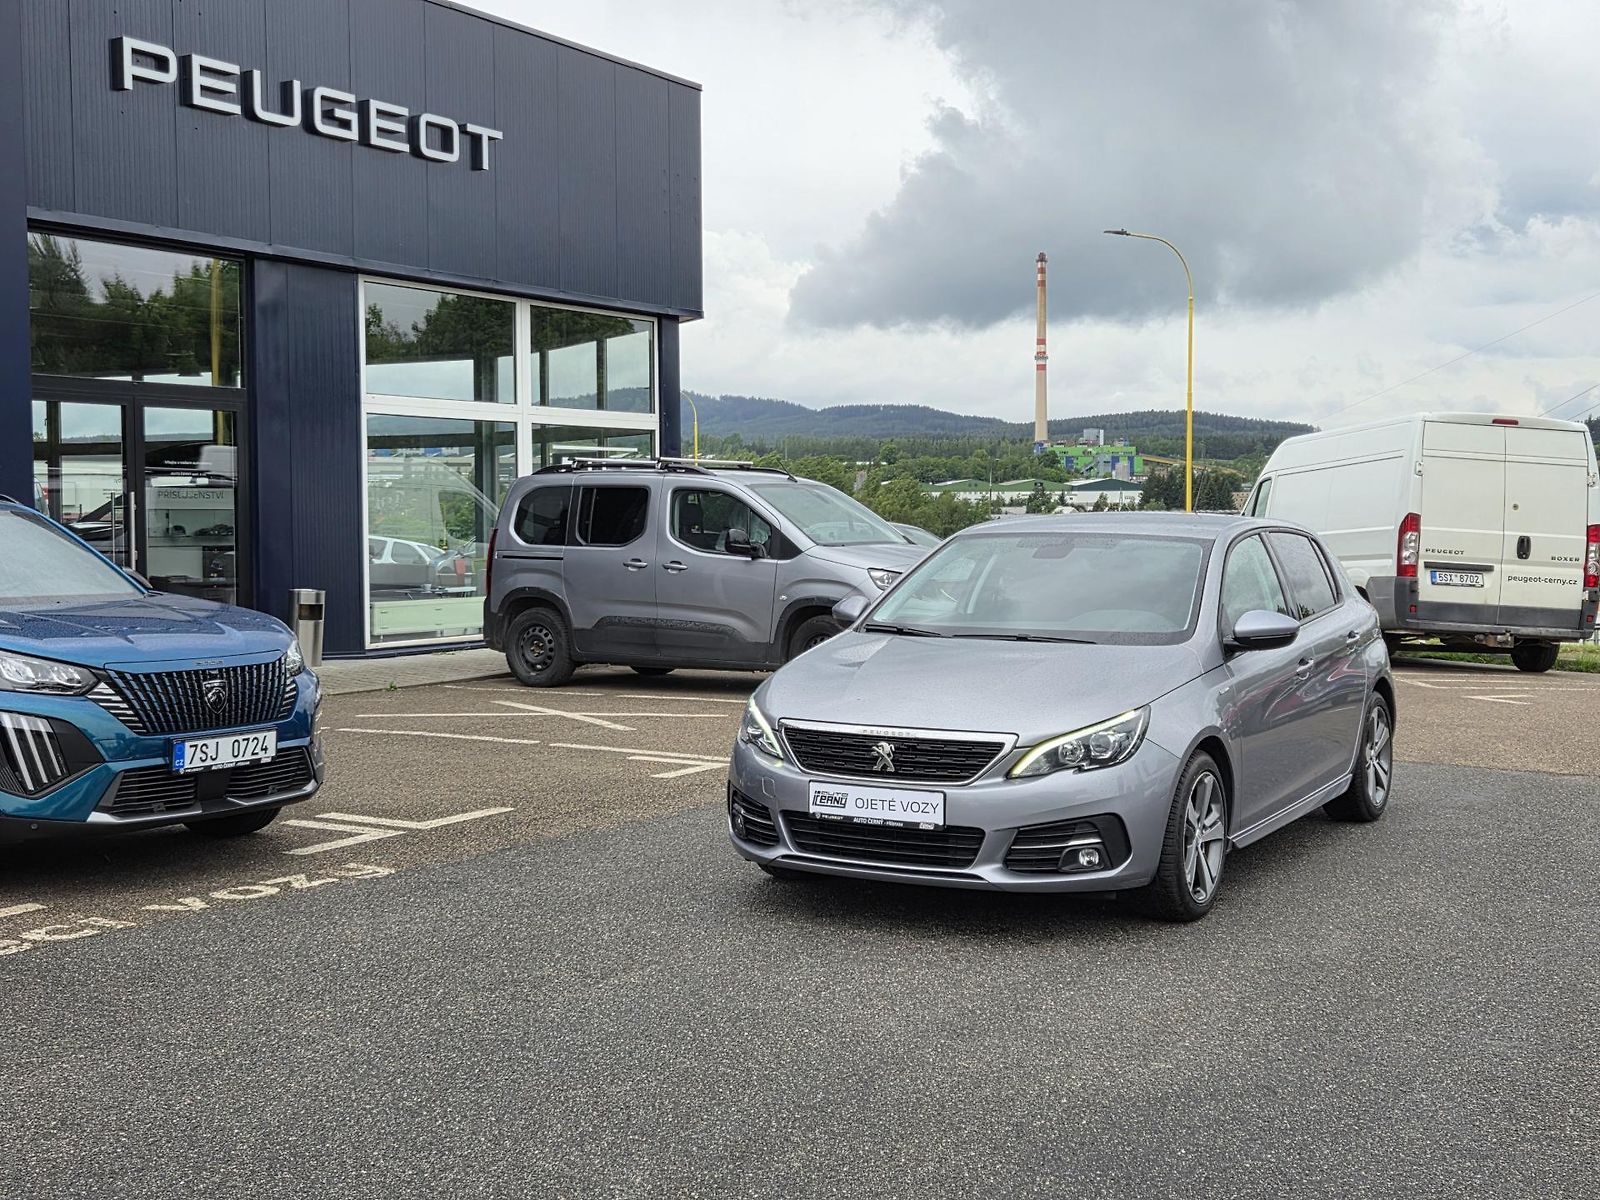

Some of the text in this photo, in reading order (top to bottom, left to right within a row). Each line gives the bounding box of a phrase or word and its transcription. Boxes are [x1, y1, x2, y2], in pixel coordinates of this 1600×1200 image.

[111, 36, 503, 171] PEUGEOT
[1438, 573, 1480, 584] 5SX 8702
[1507, 575, 1578, 586] peugeot-cerny.cz
[189, 735, 268, 765] 7SJ 0724
[855, 797, 939, 814] OJETÉ VOZY
